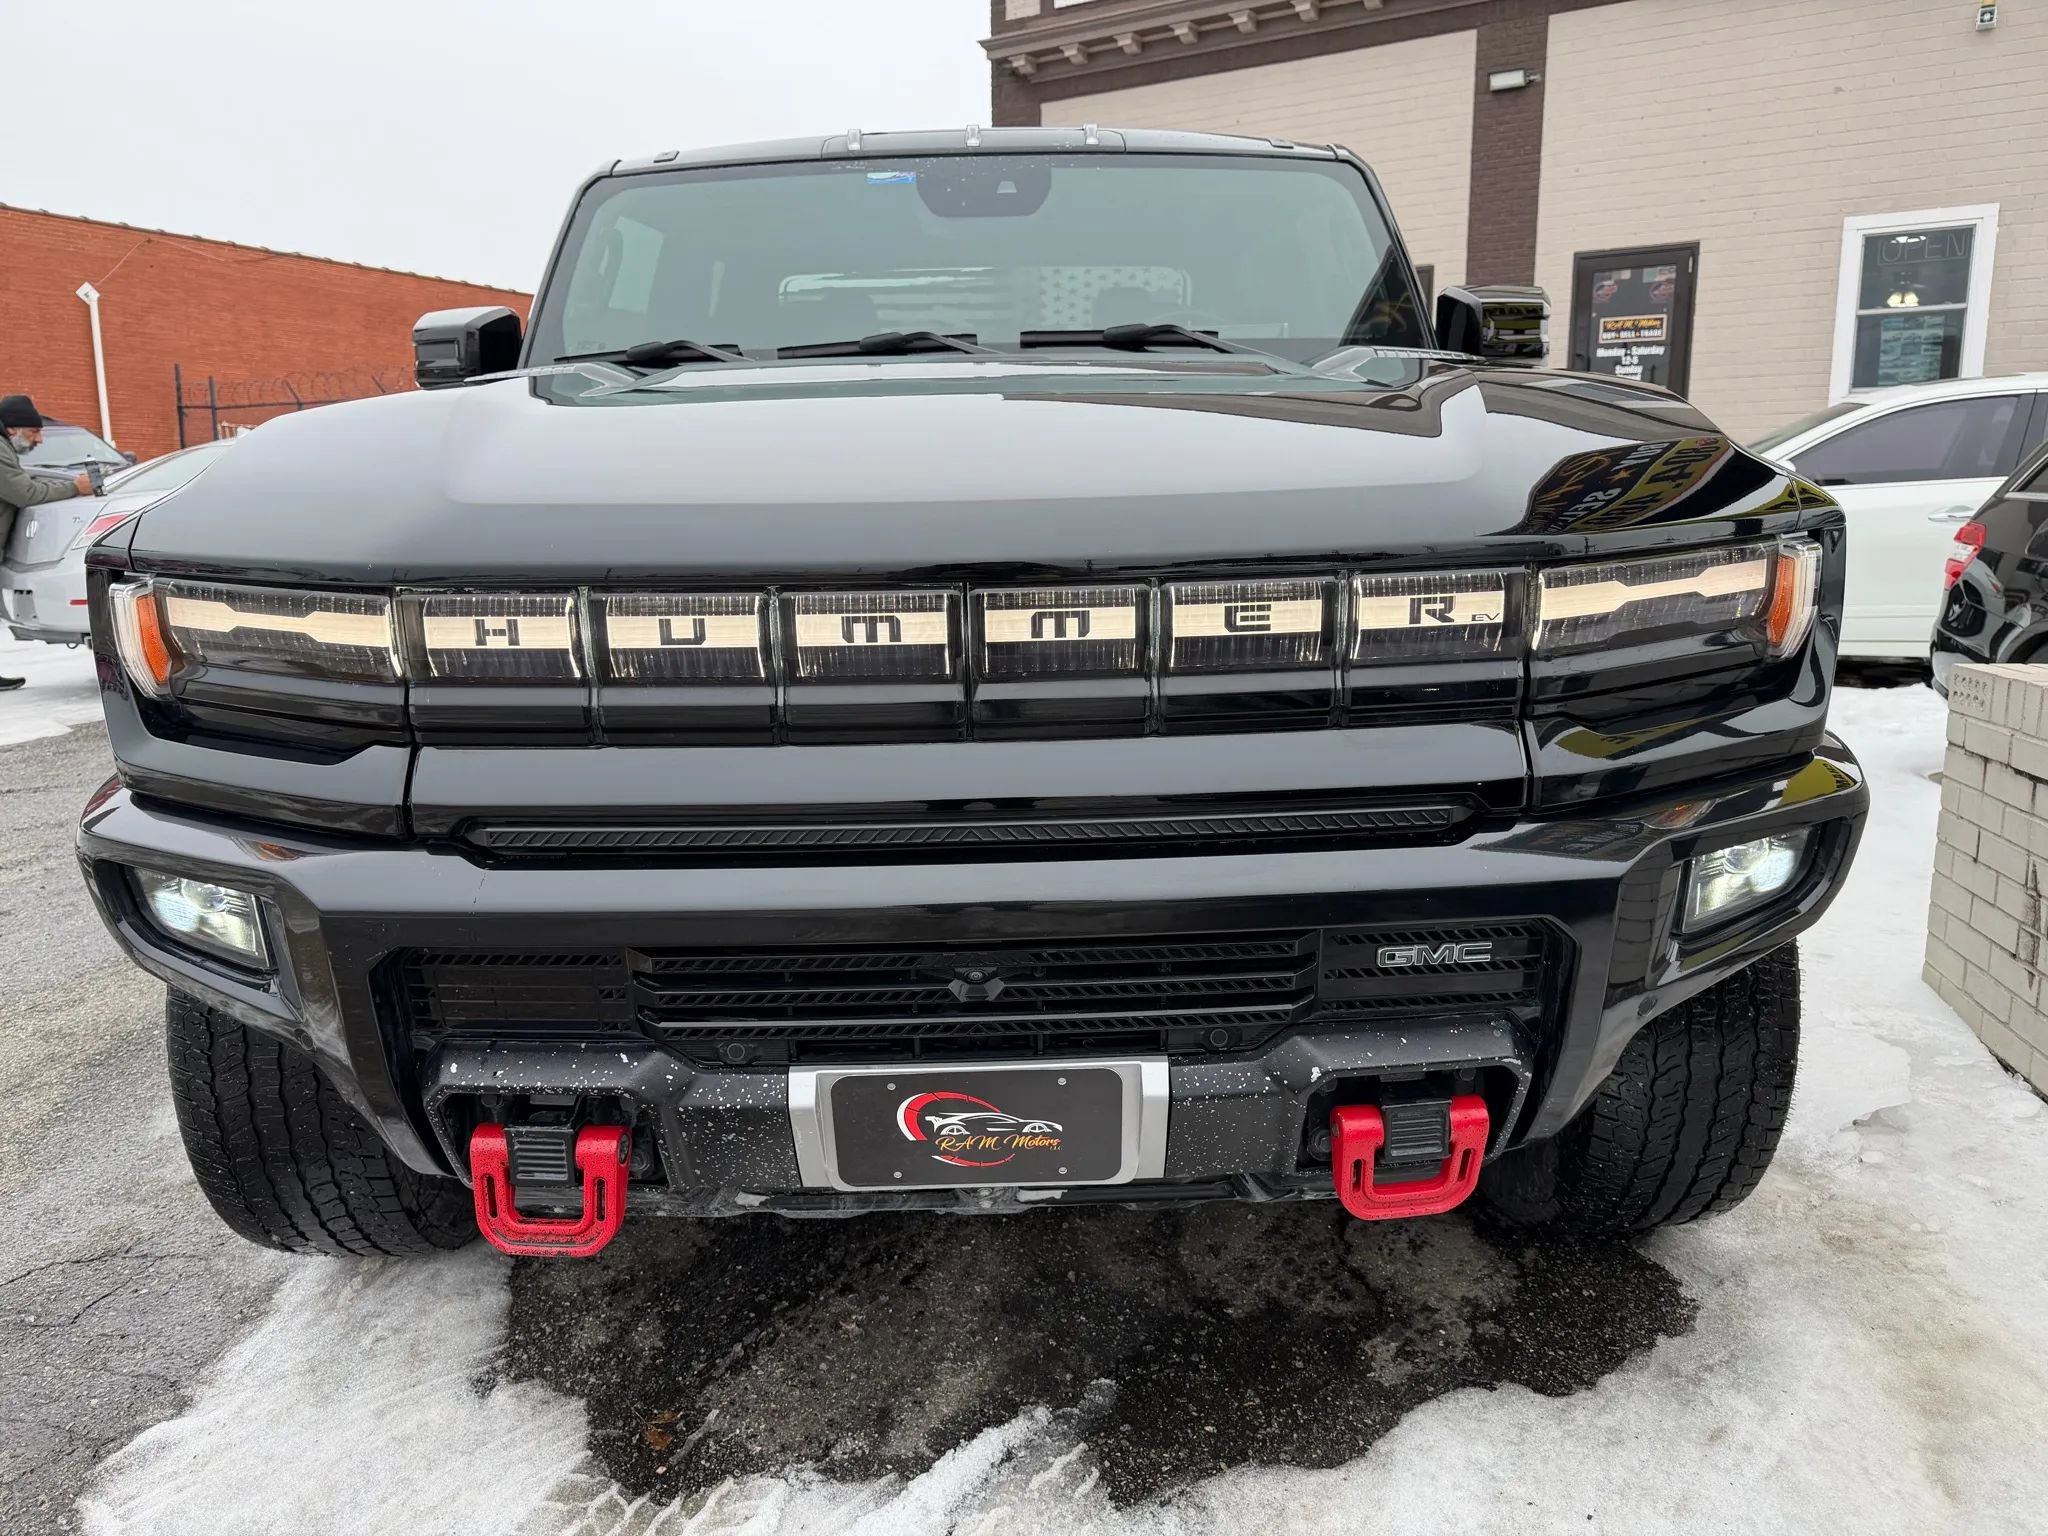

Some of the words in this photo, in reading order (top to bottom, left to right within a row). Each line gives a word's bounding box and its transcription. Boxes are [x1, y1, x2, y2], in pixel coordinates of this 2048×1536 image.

[1471, 612, 1501, 622] EV
[1377, 942, 1493, 968] GMC
[1003, 1134, 1060, 1150] Motors
